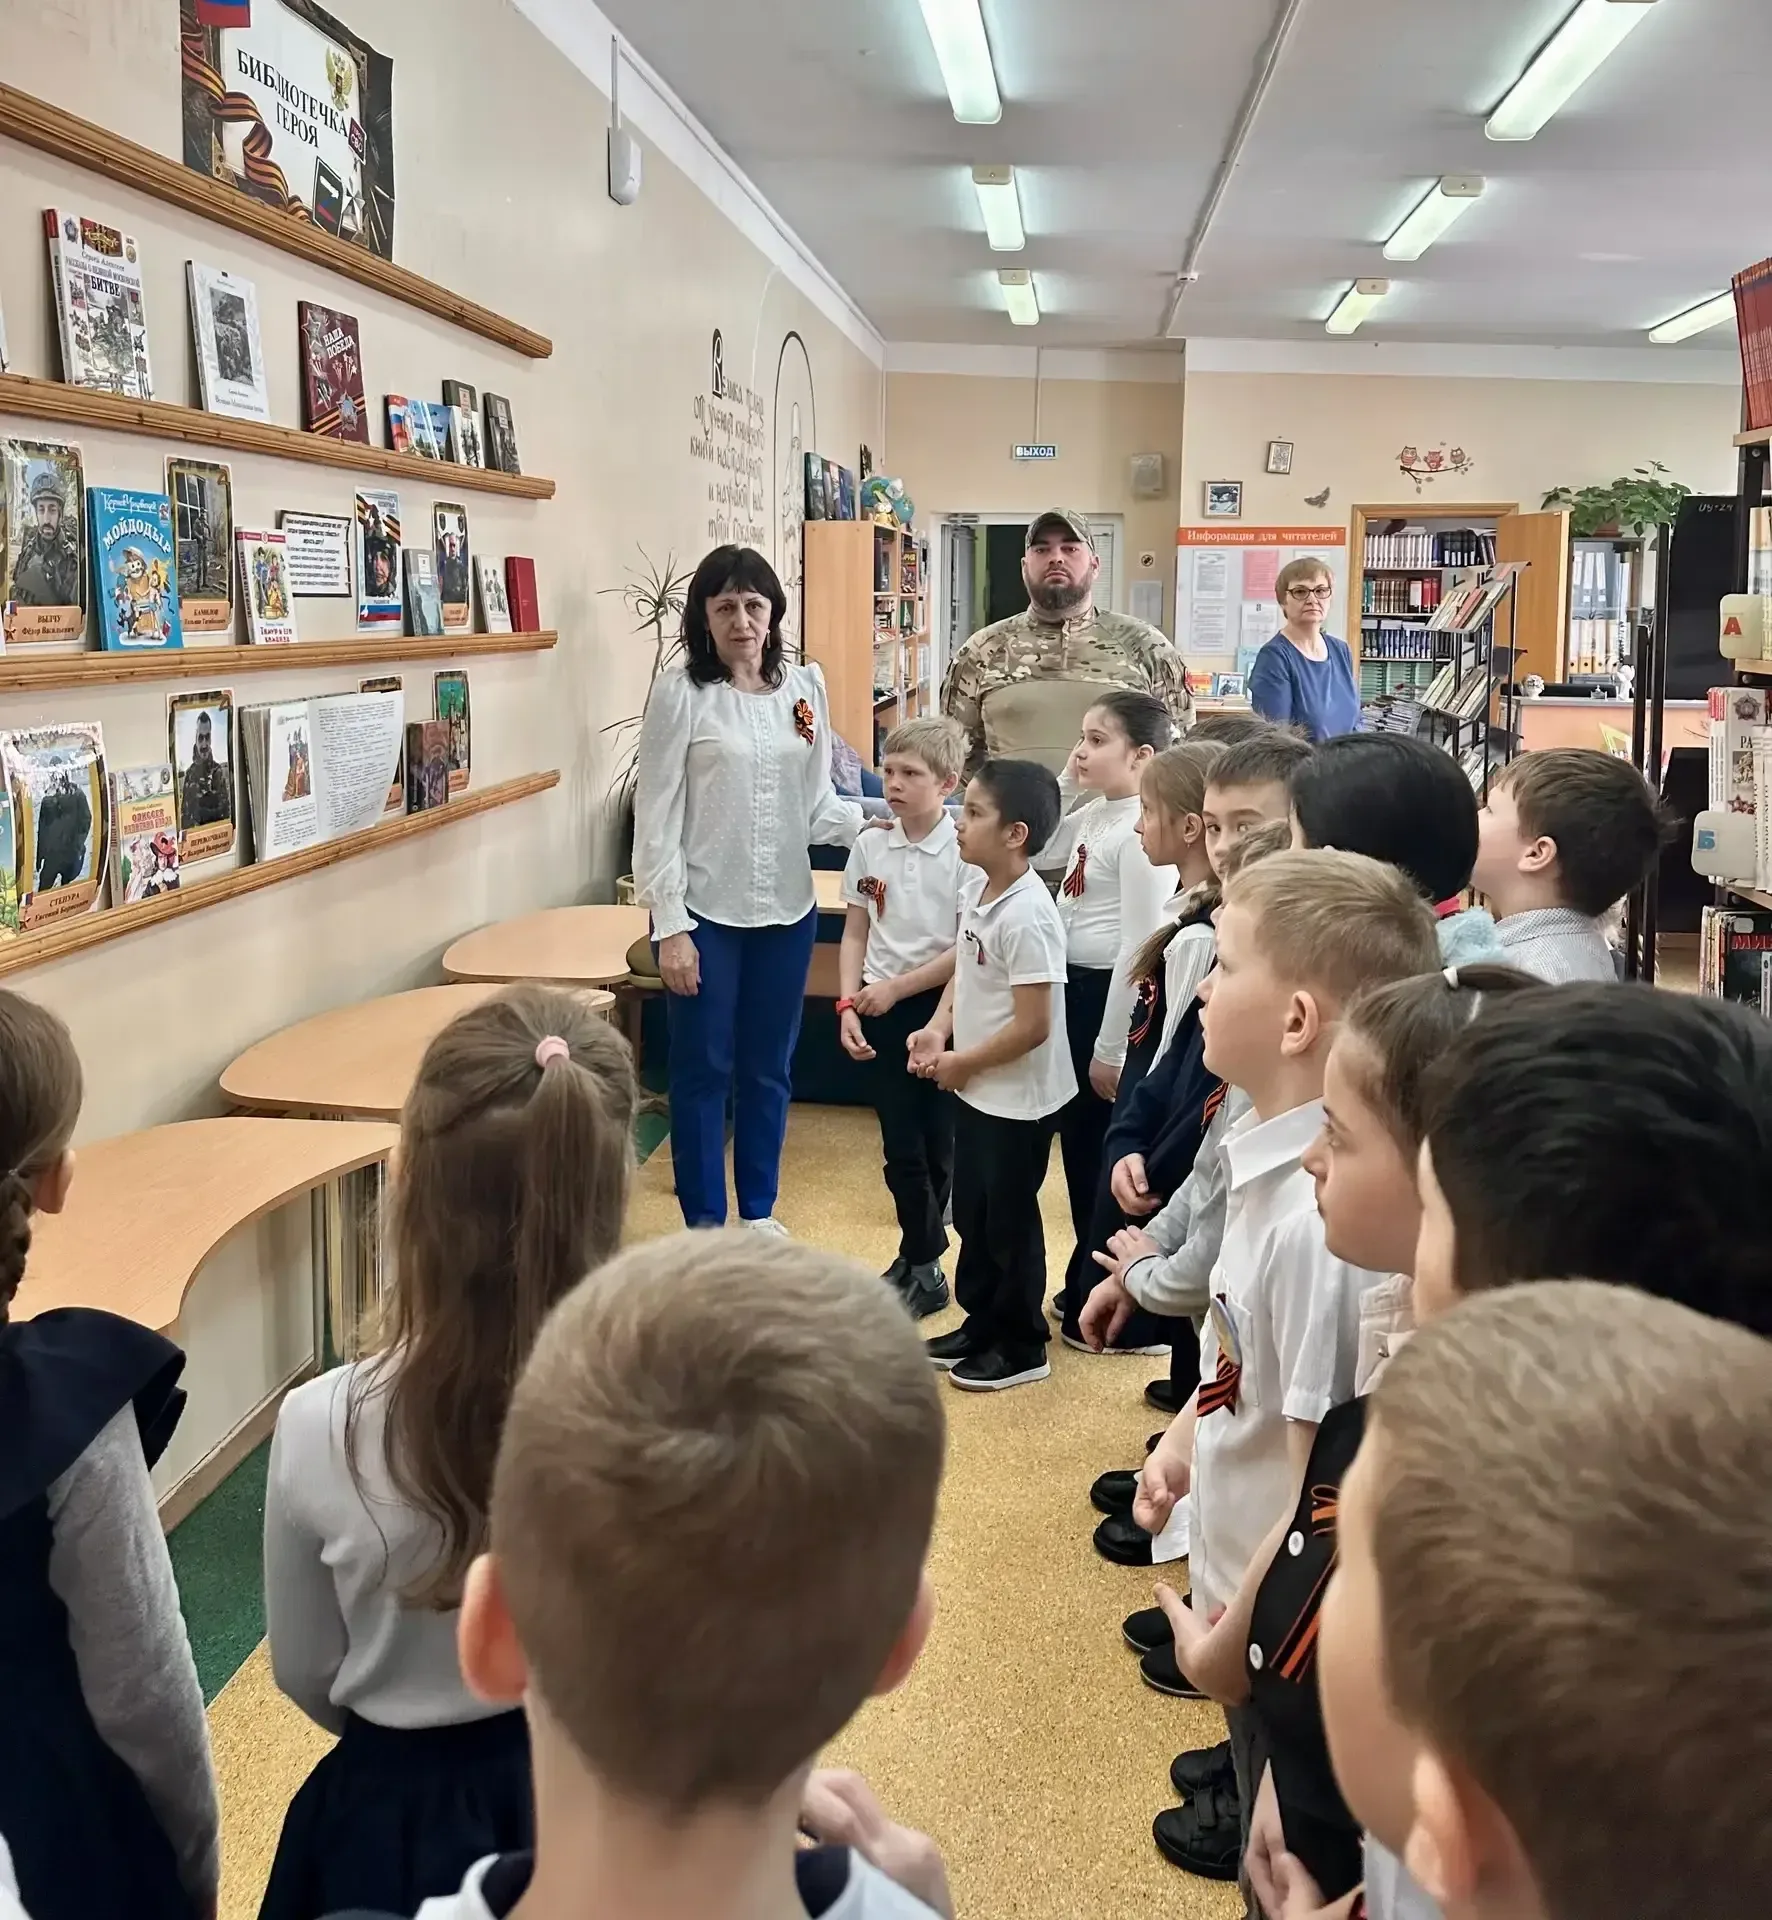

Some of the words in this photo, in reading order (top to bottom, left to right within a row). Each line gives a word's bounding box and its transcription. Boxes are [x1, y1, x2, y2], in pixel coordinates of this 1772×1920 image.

[237, 48, 348, 137] БИБЛИОТЕЧКА
[276, 102, 319, 148] ГЕРОЯ
[91, 275, 120, 297] БИТВЕ
[324, 327, 344, 346] НАША
[327, 335, 355, 359] ПОБЕДА
[1016, 446, 1054, 457] ВЫХОД
[103, 516, 171, 553] МОЙДОДЫР
[1187, 530, 1255, 542] Информация
[1258, 531, 1277, 542] для
[1282, 530, 1338, 542] читателей
[1723, 616, 1742, 635] А
[1740, 736, 1753, 748] РА
[1697, 829, 1715, 850] Б
[1731, 935, 1772, 950] МИ
